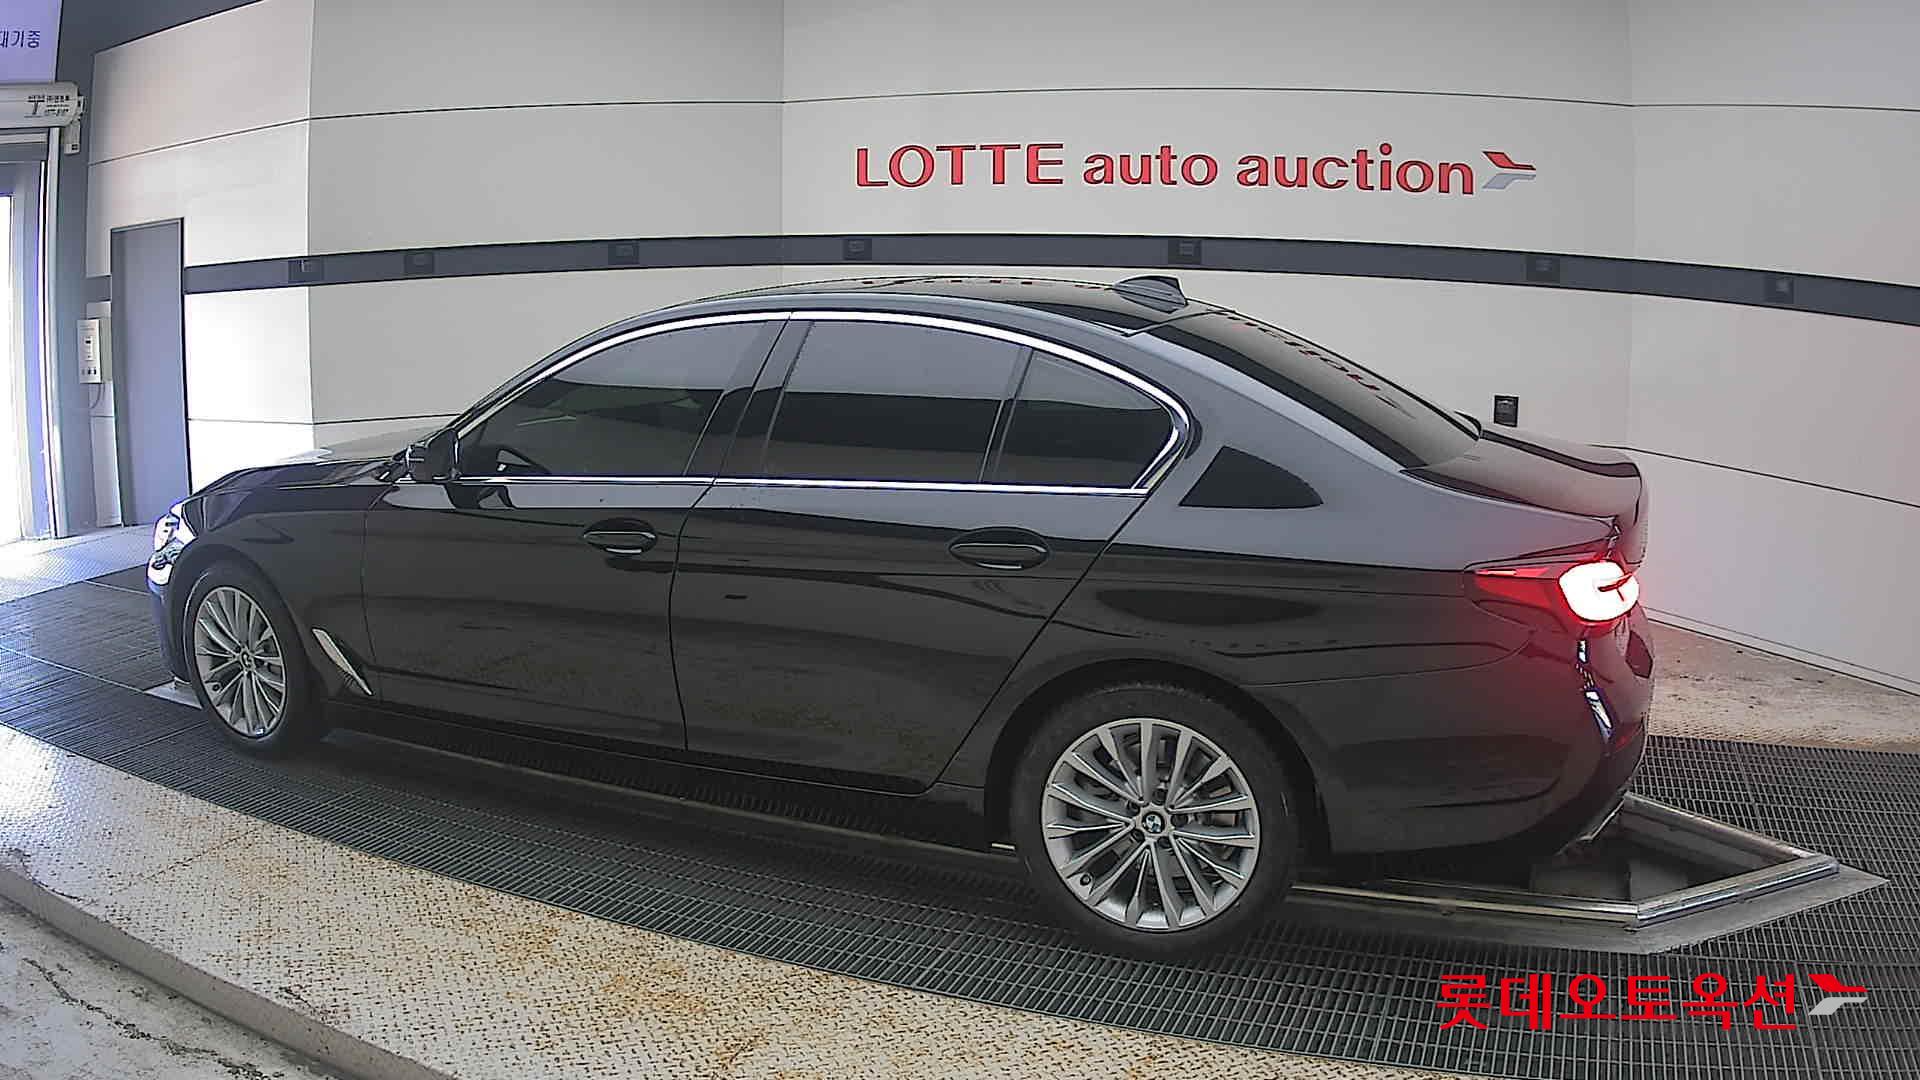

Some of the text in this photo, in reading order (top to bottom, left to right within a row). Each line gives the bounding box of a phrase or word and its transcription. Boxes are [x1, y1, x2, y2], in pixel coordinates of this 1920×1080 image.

[856, 142, 1474, 195] LOTTE auto auction
